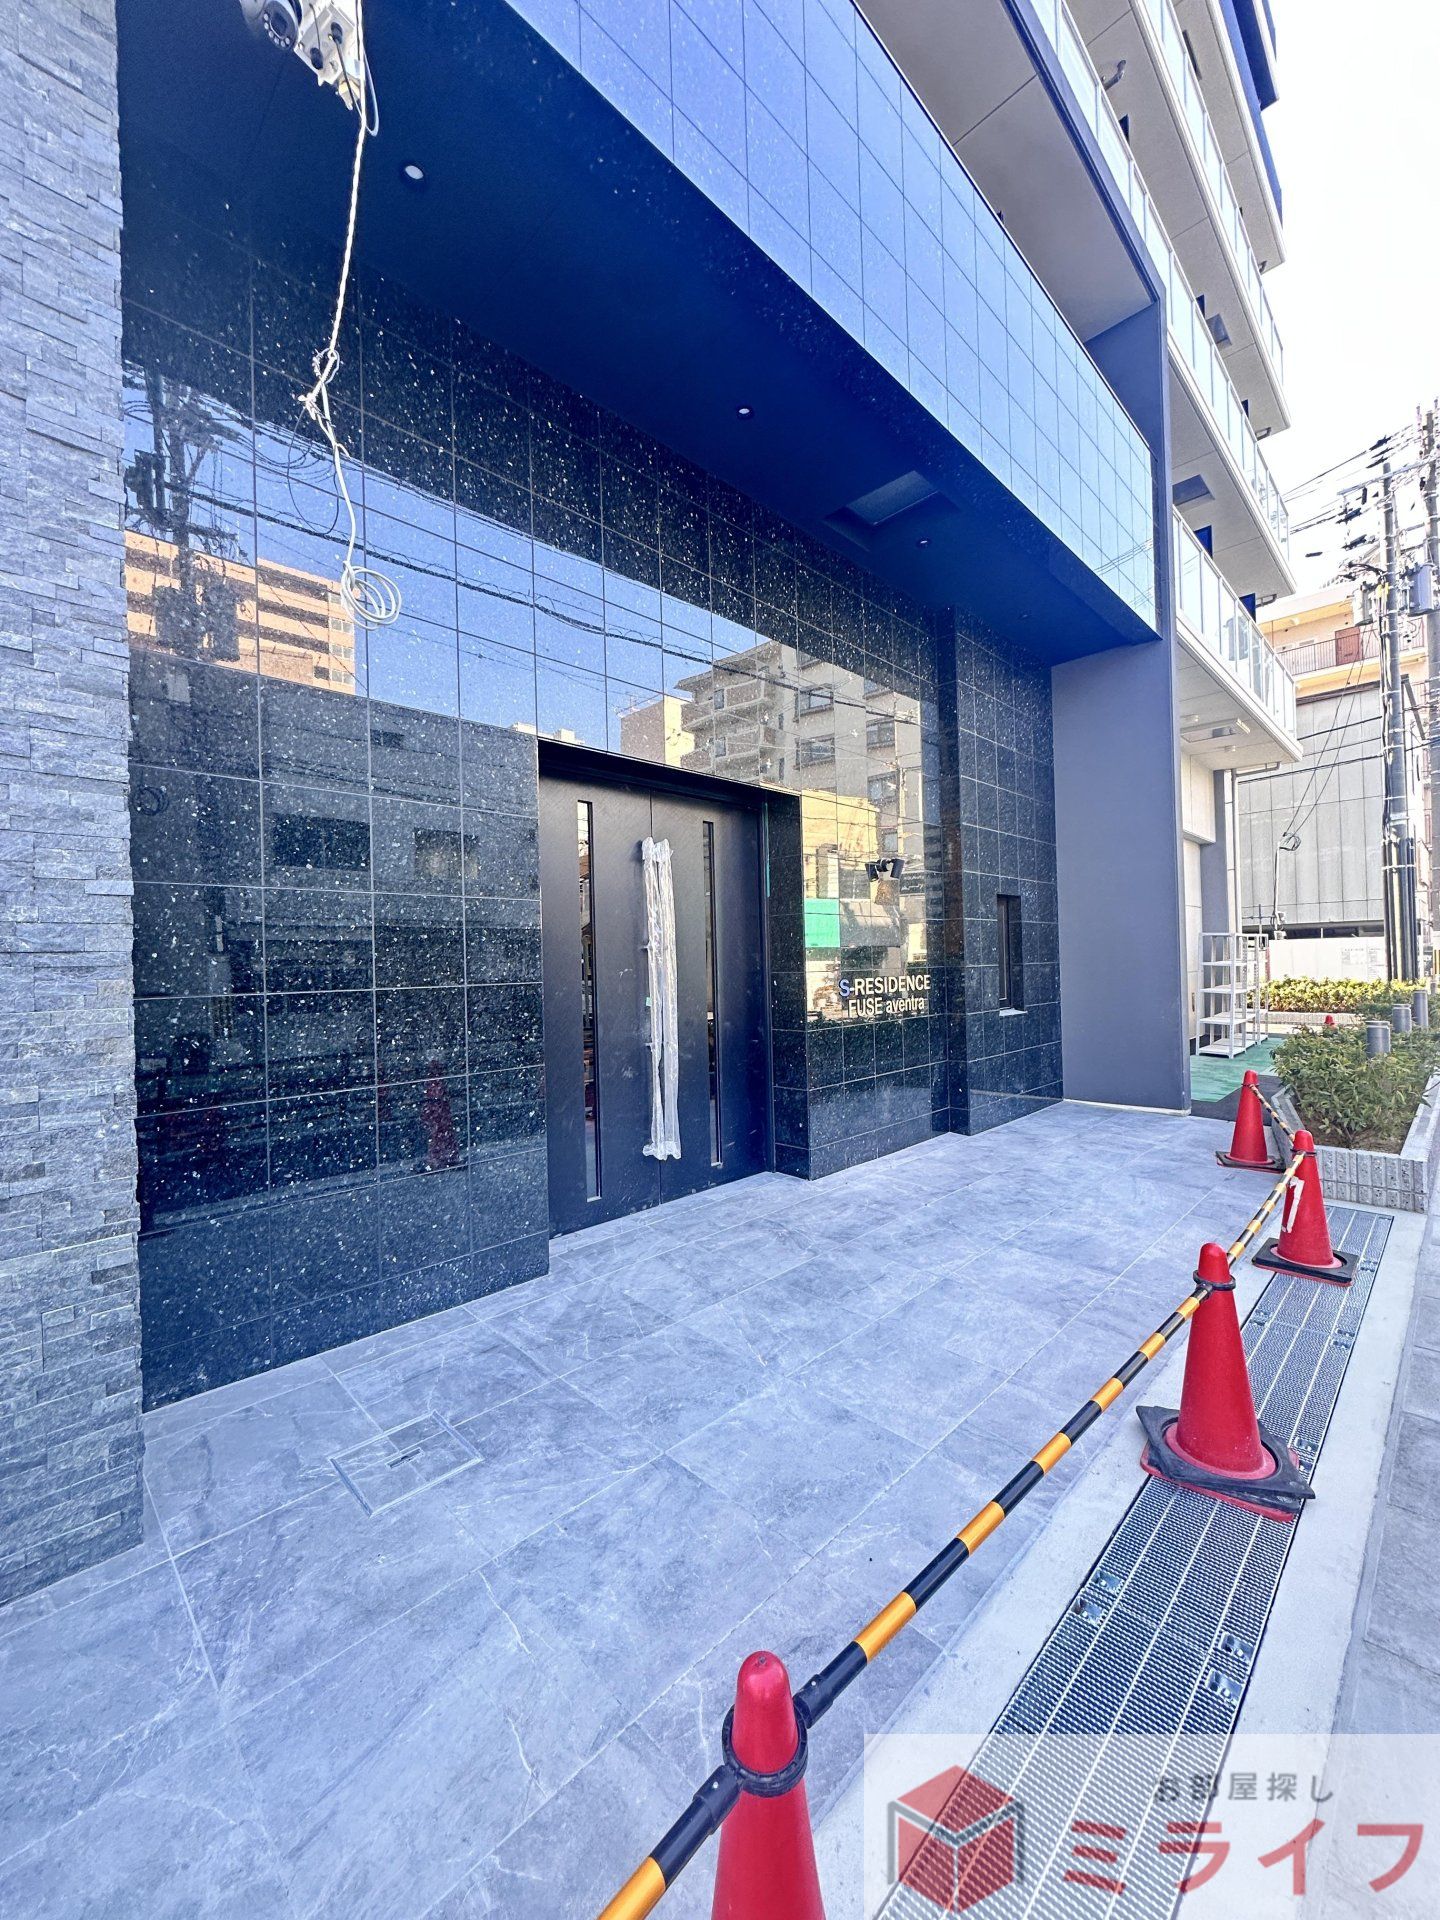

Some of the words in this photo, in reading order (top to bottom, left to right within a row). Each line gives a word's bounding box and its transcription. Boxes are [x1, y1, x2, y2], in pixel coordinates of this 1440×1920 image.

[839, 974, 931, 997] S-RESIDENCE
[848, 997, 883, 1018] FUSE
[885, 996, 925, 1014] aventra
